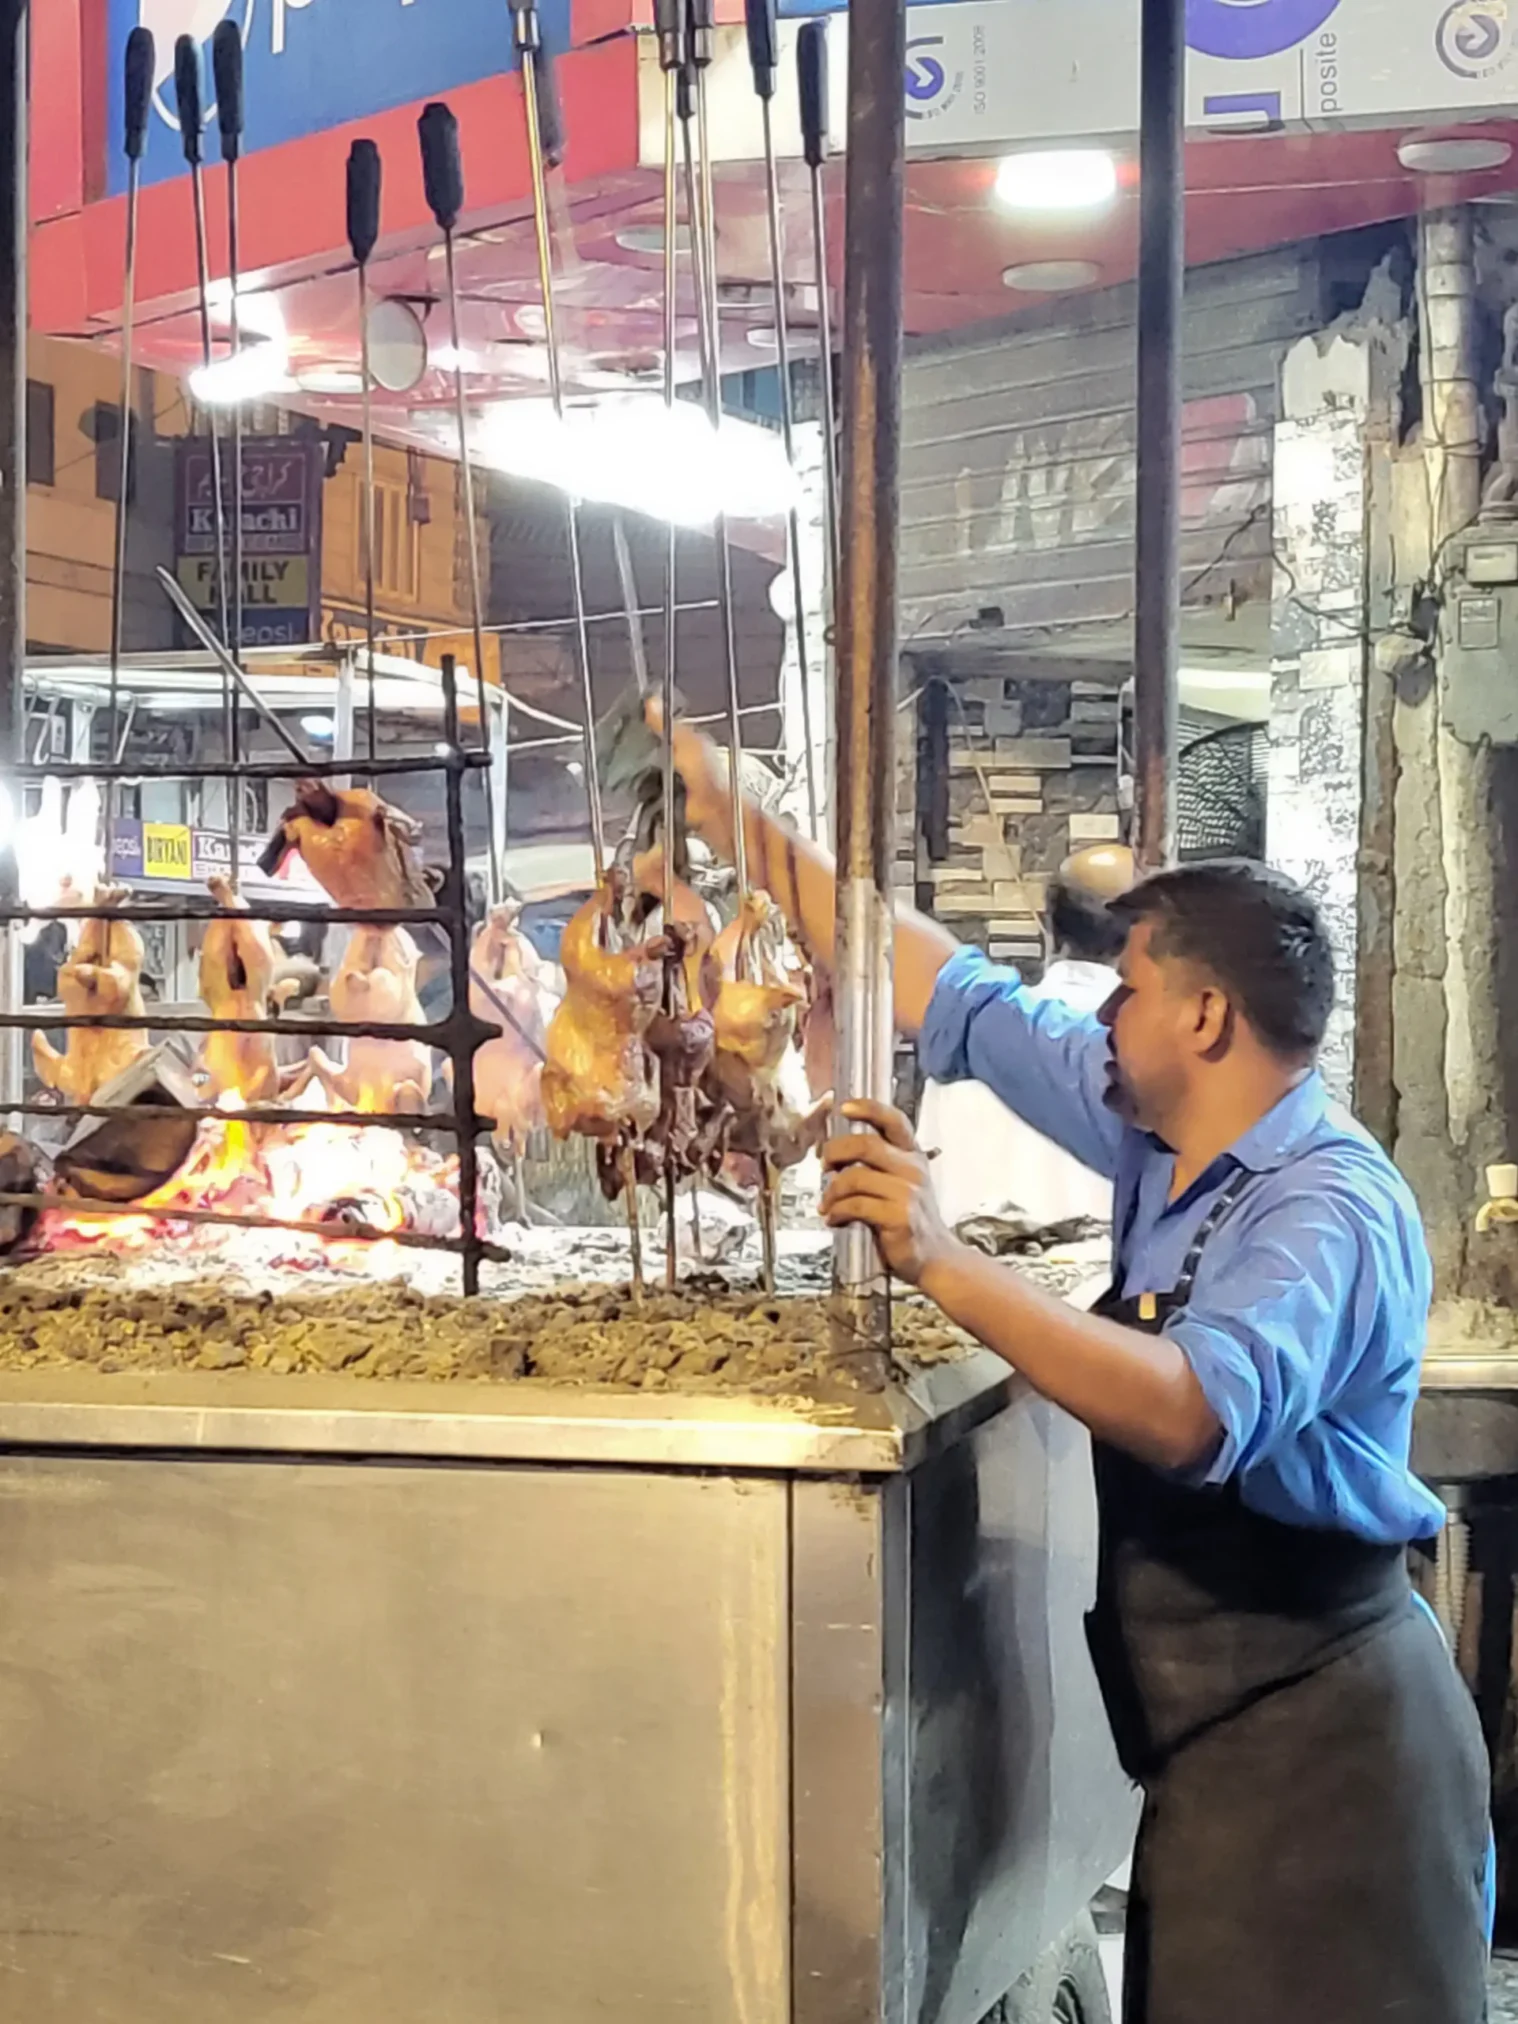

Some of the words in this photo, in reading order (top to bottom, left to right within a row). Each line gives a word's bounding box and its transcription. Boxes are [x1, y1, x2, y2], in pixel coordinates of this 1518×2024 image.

[1314, 32, 1344, 114] posite
[191, 506, 298, 533] Kachi
[208, 583, 278, 604] LL
[236, 621, 295, 645] epsi
[112, 836, 141, 860] epsi
[146, 835, 188, 867] BIRYANI
